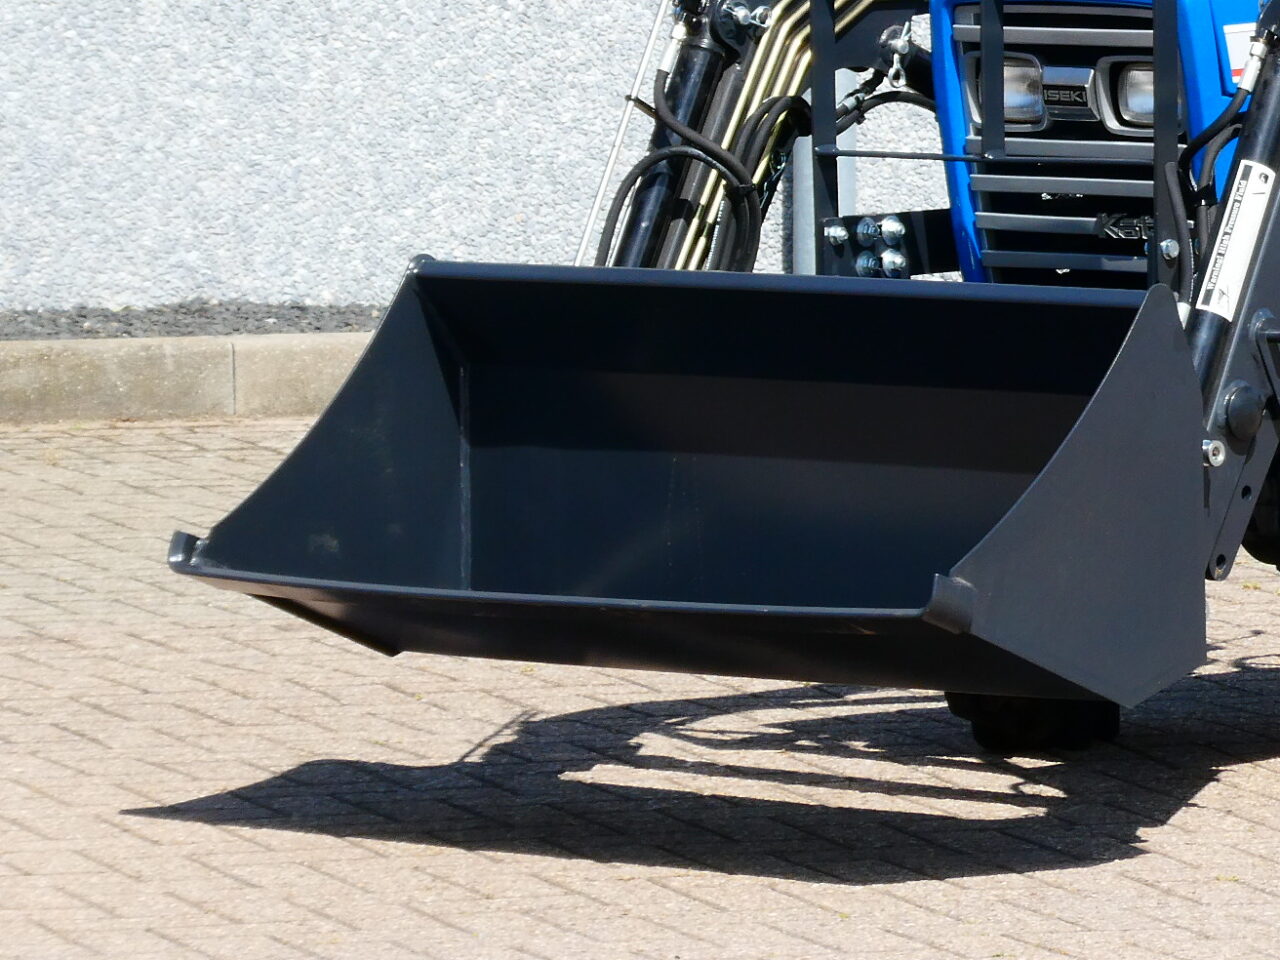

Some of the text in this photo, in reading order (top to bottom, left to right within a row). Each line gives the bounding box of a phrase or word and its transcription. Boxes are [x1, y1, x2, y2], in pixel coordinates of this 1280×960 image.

[1044, 89, 1087, 102] ISEKI
[1217, 234, 1231, 255] High
[1224, 201, 1240, 233] Pressure
